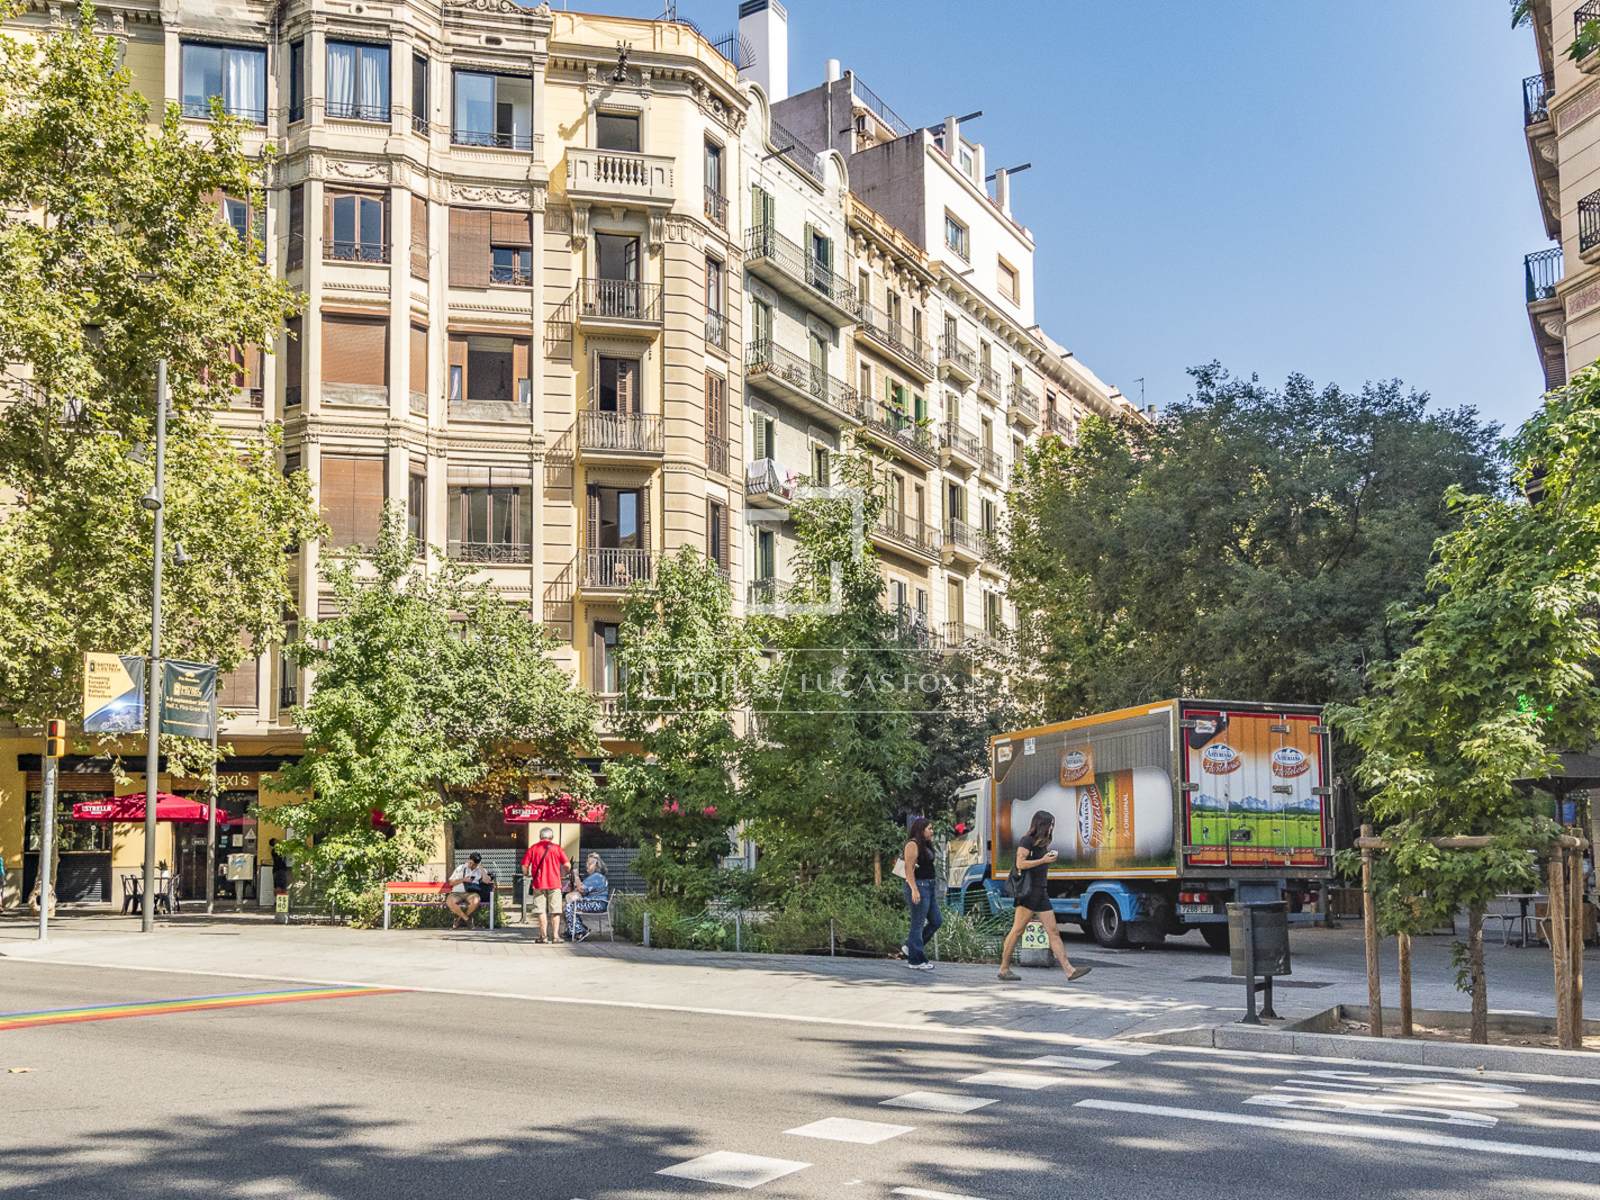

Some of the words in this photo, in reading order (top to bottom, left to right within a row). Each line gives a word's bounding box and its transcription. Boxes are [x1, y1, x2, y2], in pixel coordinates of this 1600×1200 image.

[215, 772, 250, 786] exi's
[1082, 798, 1090, 841] ASTURIANA
[1241, 1070, 1526, 1128] BUS
